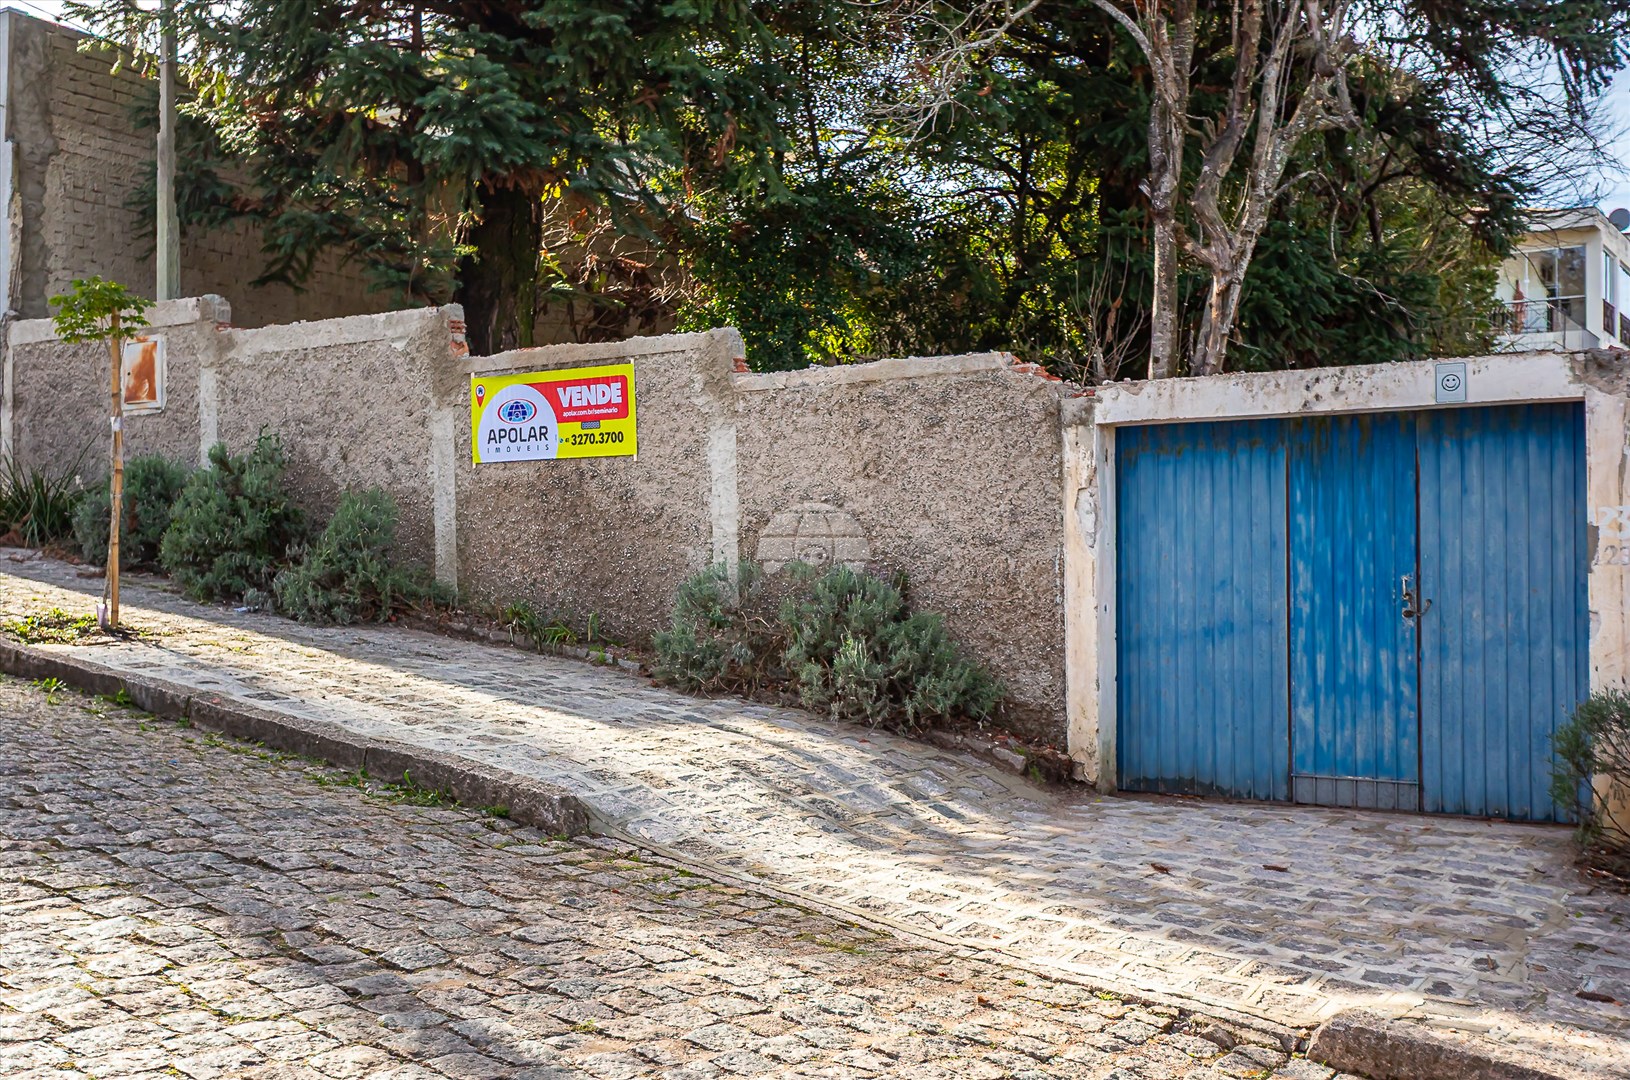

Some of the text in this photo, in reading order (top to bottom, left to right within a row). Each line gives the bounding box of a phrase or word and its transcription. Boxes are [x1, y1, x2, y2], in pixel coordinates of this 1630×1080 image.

[557, 382, 622, 408] VENDE
[487, 425, 549, 445] APOLAR
[571, 430, 624, 445] 3270.3700
